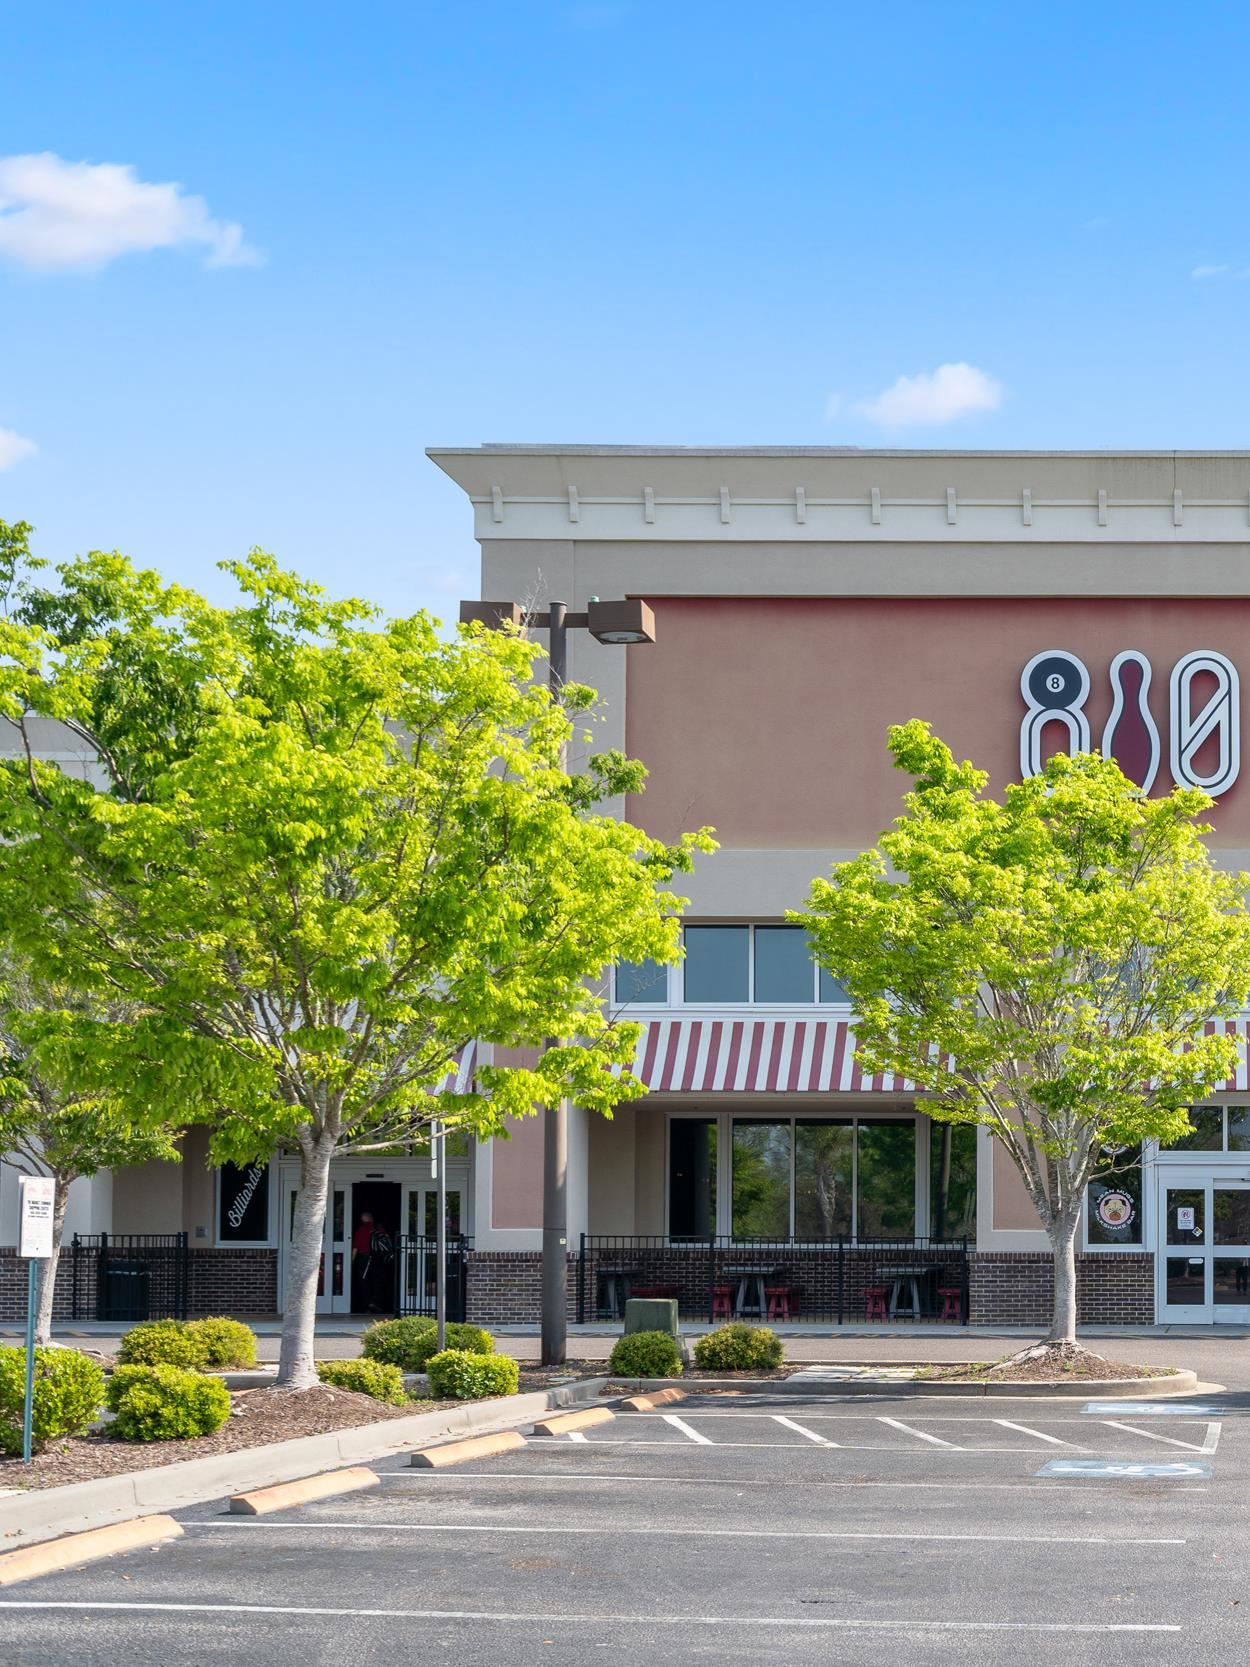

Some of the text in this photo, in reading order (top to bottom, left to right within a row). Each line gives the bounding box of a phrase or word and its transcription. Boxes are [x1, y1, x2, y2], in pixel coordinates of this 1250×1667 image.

[1051, 676, 1060, 689] 8
[228, 1167, 262, 1228] Billiards
[1096, 1189, 1115, 1203] MEAN
[1095, 1210, 1136, 1230] MILKSHAKE BAR
